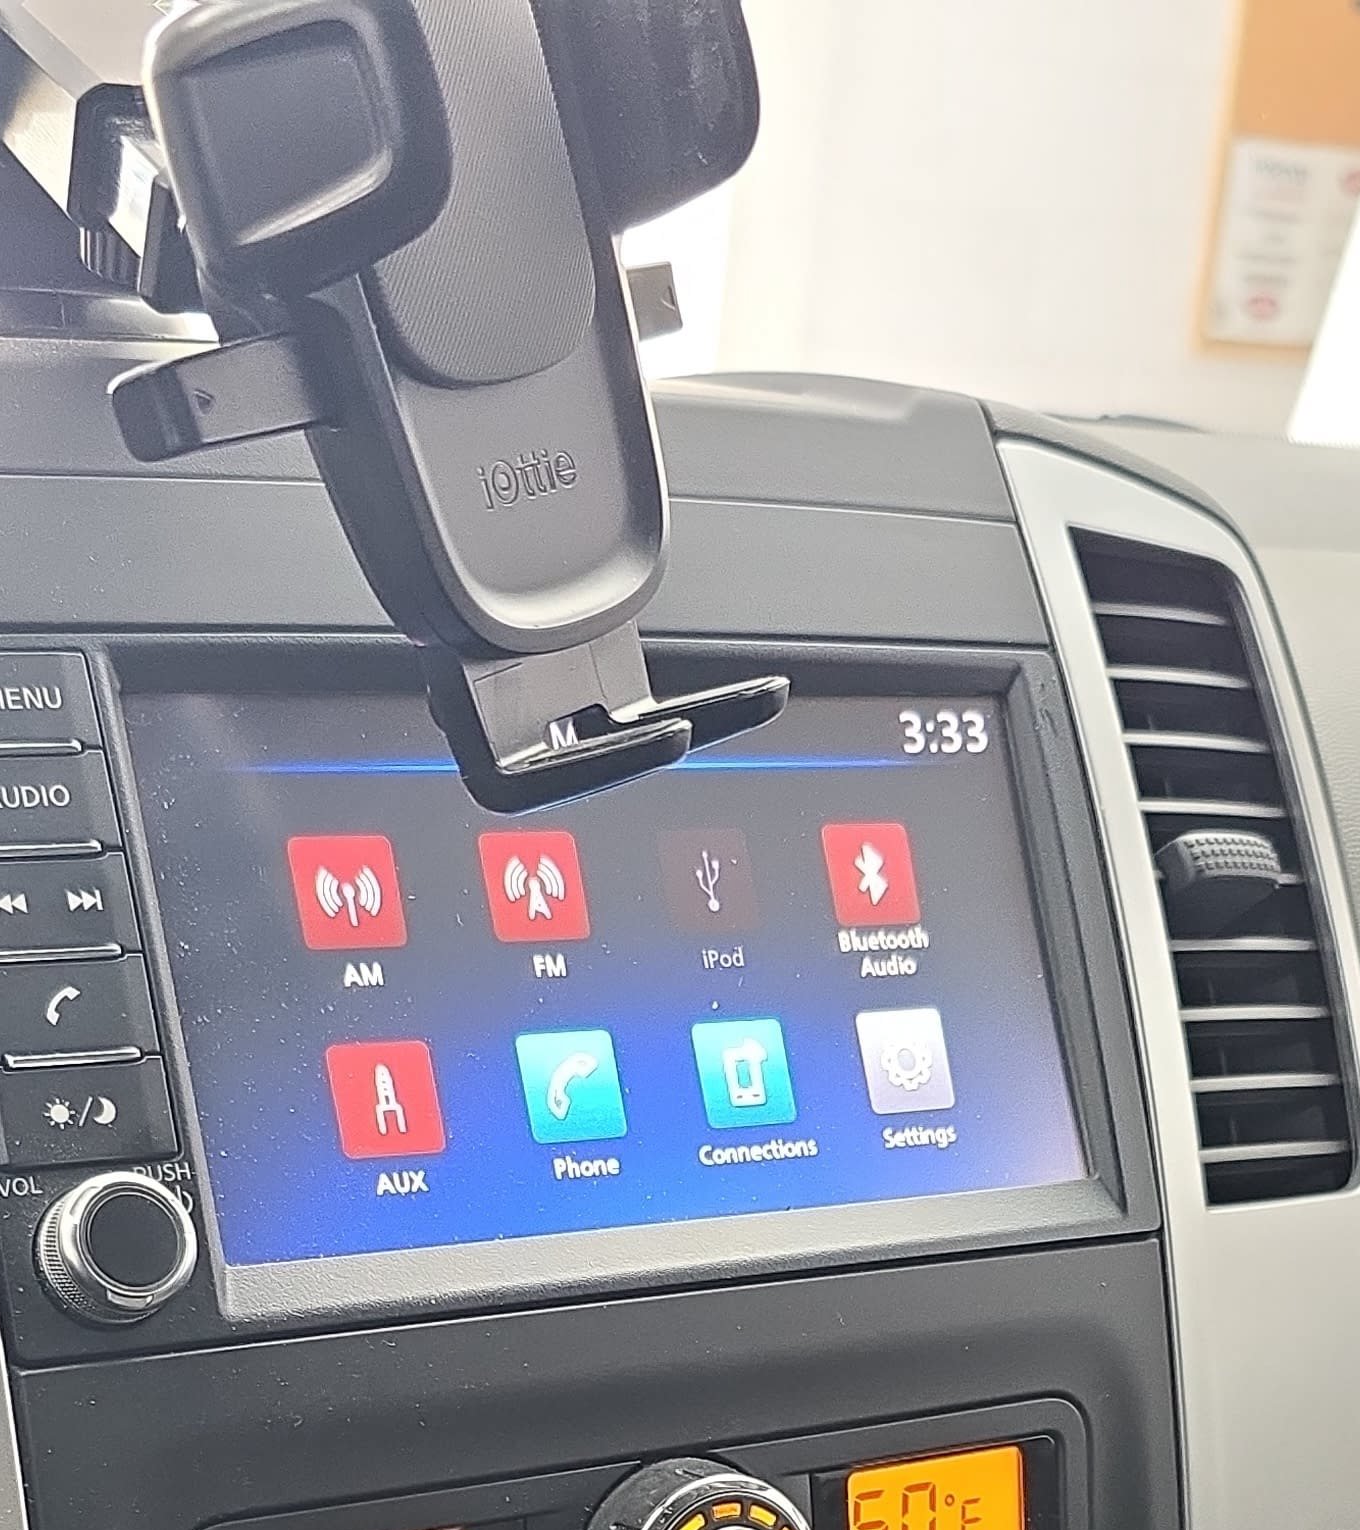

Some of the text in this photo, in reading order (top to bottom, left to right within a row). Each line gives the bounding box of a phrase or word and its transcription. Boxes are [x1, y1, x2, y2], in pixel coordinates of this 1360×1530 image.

[476, 449, 577, 511] iOttie
[897, 711, 989, 754] 3:33
[837, 926, 930, 954] Bluetooth
[533, 954, 567, 979] FM
[702, 947, 745, 972] iPod
[861, 954, 917, 978] Audio
[343, 962, 384, 988] AM
[882, 1124, 957, 1151] Settings
[698, 1137, 819, 1167] Connections
[375, 1167, 430, 1195] AUX
[553, 1155, 620, 1181] Phone
